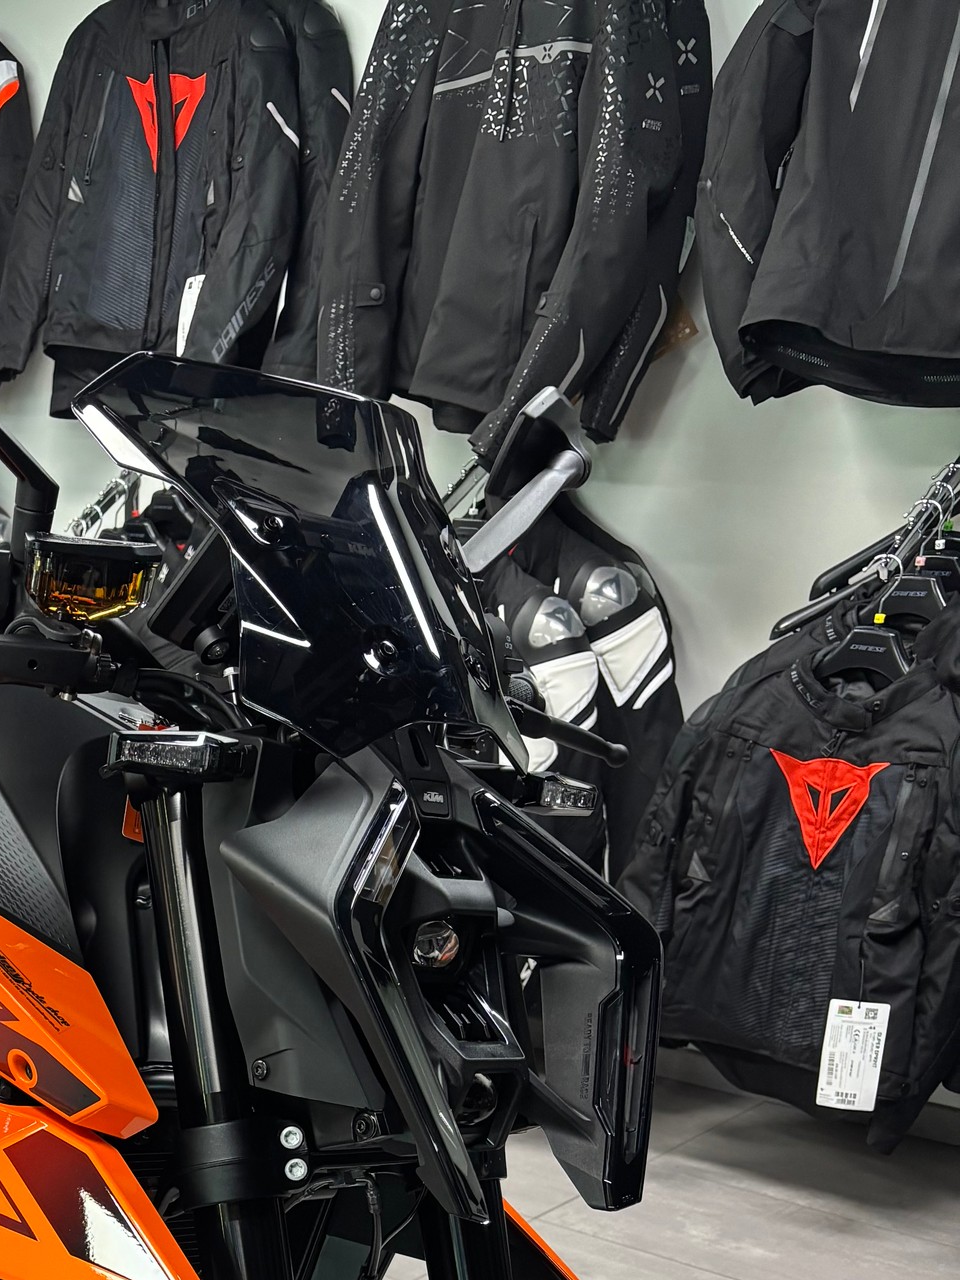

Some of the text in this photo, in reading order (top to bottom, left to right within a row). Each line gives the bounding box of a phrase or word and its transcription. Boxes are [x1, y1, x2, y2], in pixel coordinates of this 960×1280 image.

[211, 256, 276, 363] DAINESE
[849, 643, 886, 653] DAINESE
[423, 791, 444, 804] KTM
